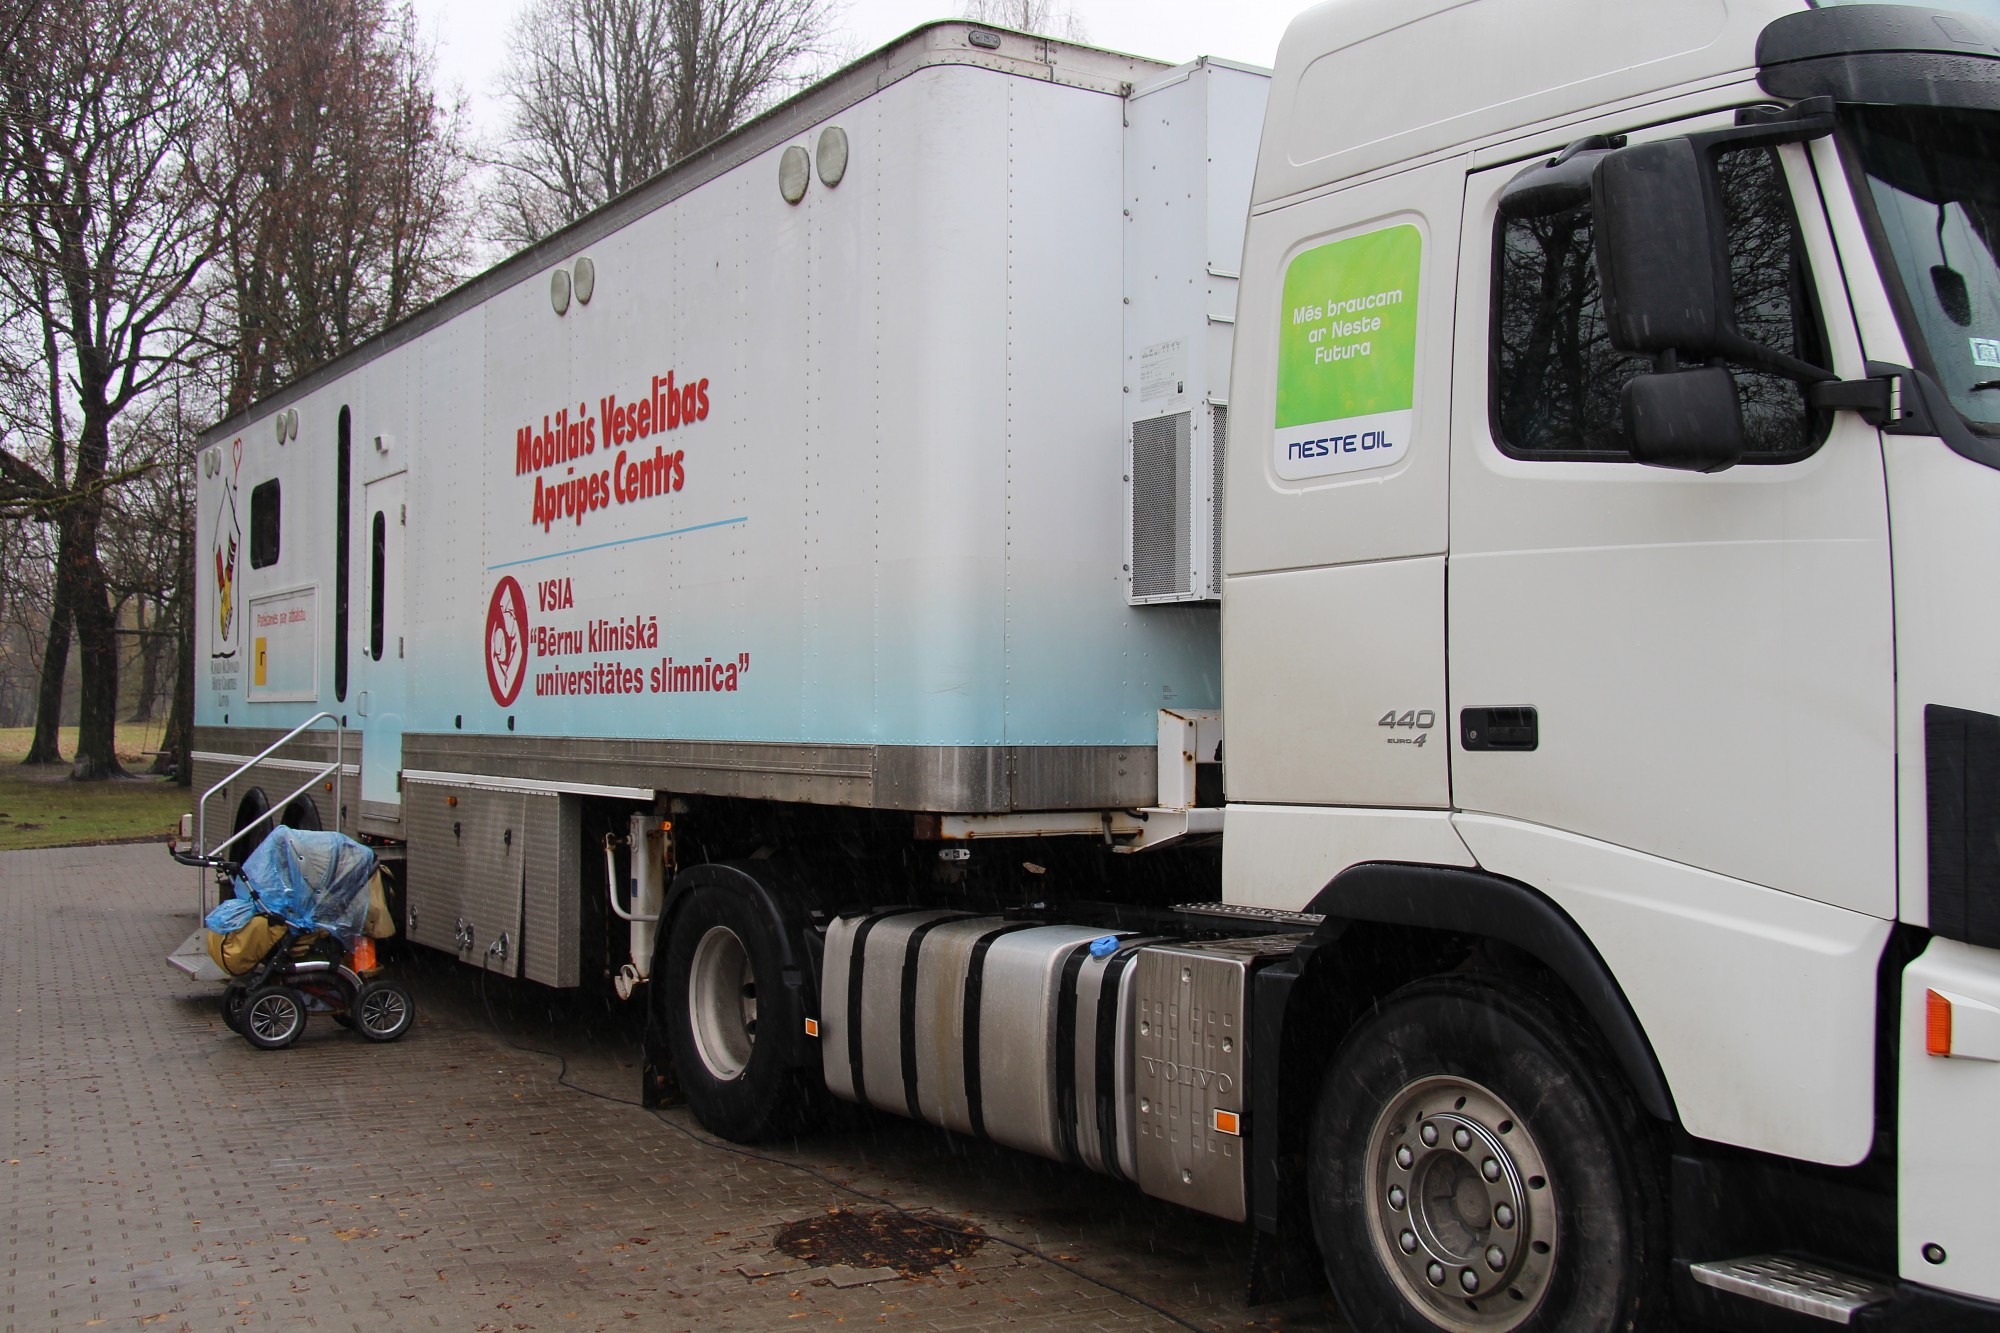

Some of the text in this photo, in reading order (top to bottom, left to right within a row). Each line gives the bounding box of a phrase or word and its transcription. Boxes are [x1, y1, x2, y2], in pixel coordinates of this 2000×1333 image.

[1293, 289, 1402, 325] Mēs braucam
[1308, 316, 1381, 344] ar Neste
[1314, 341, 1371, 365] Futura
[516, 369, 710, 476] Mobilais Veselības
[1288, 430, 1393, 461] NESTE OIL
[532, 445, 685, 533] Aprūpes Centrs
[538, 577, 573, 612] VSIA
[588, 615, 658, 653] klīniskā
[536, 661, 644, 696] universitātes
[1378, 709, 1436, 730] 440
[1141, 1055, 1233, 1094] VOLVO
